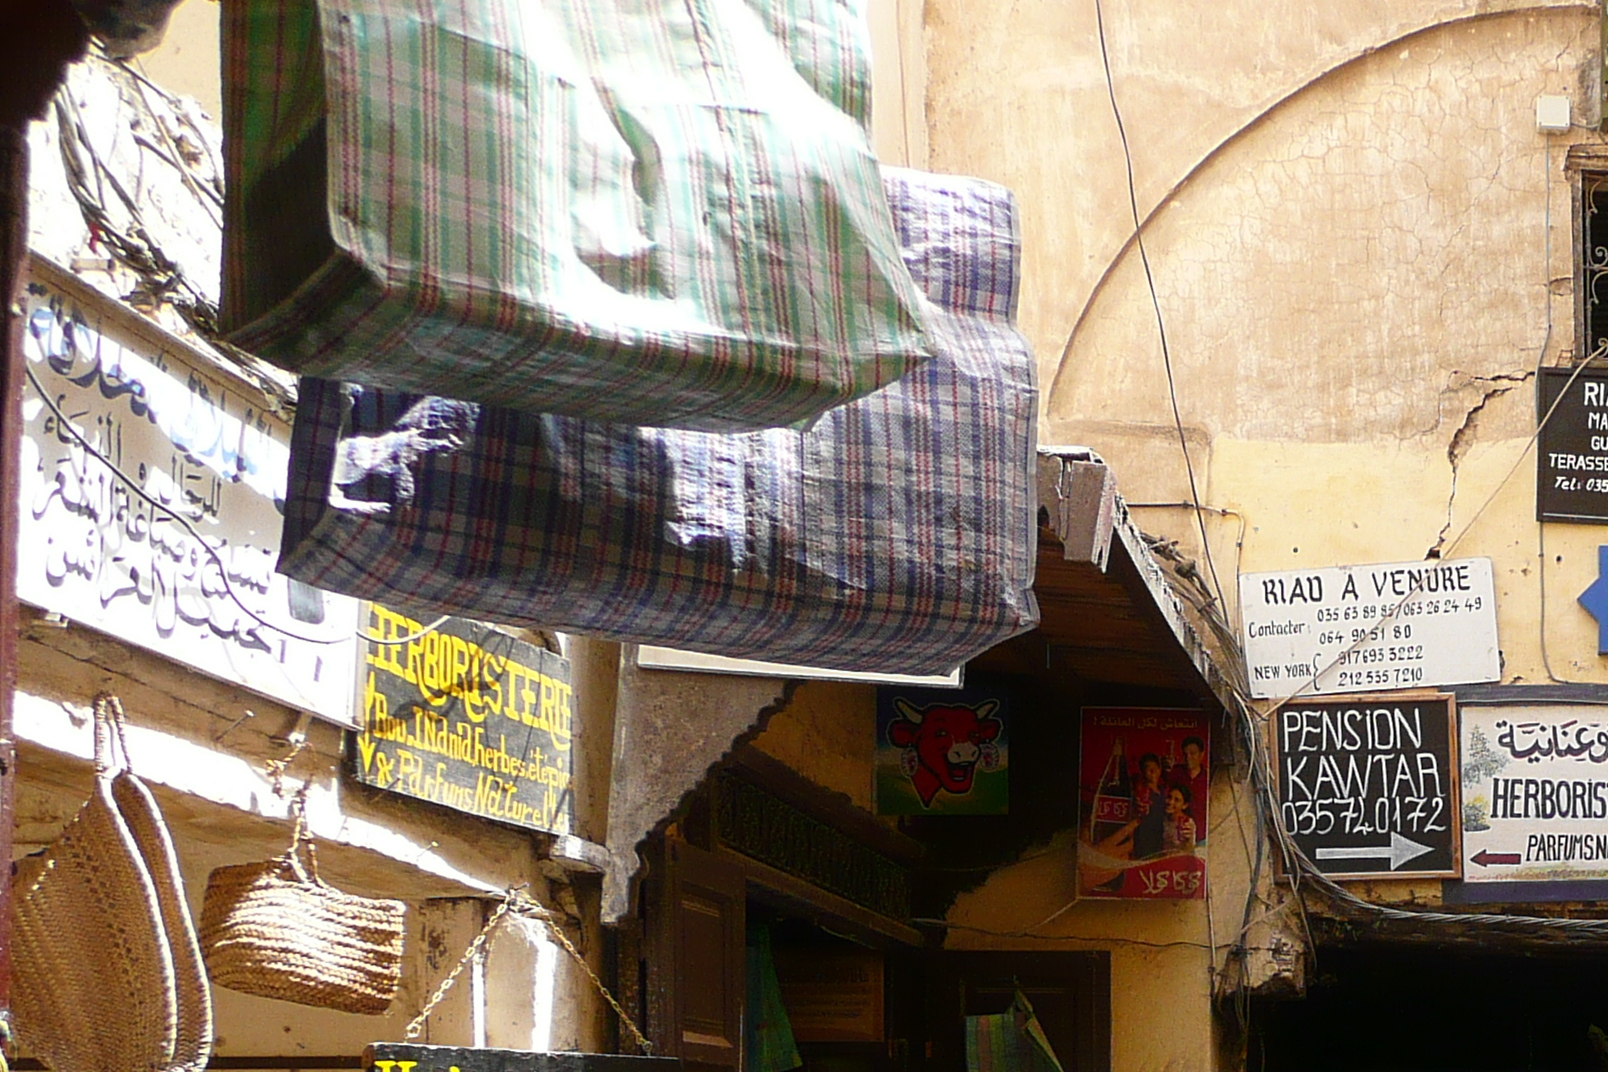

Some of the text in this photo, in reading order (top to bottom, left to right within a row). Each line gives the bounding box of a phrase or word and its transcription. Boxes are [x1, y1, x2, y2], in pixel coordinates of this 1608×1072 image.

[1262, 565, 1471, 606] RIAD A VENDRE
[1317, 607, 1339, 623] 035
[1254, 661, 1312, 682] NEW YORK
[1283, 708, 1421, 752] PENSION
[1286, 752, 1446, 801] KAWTAR
